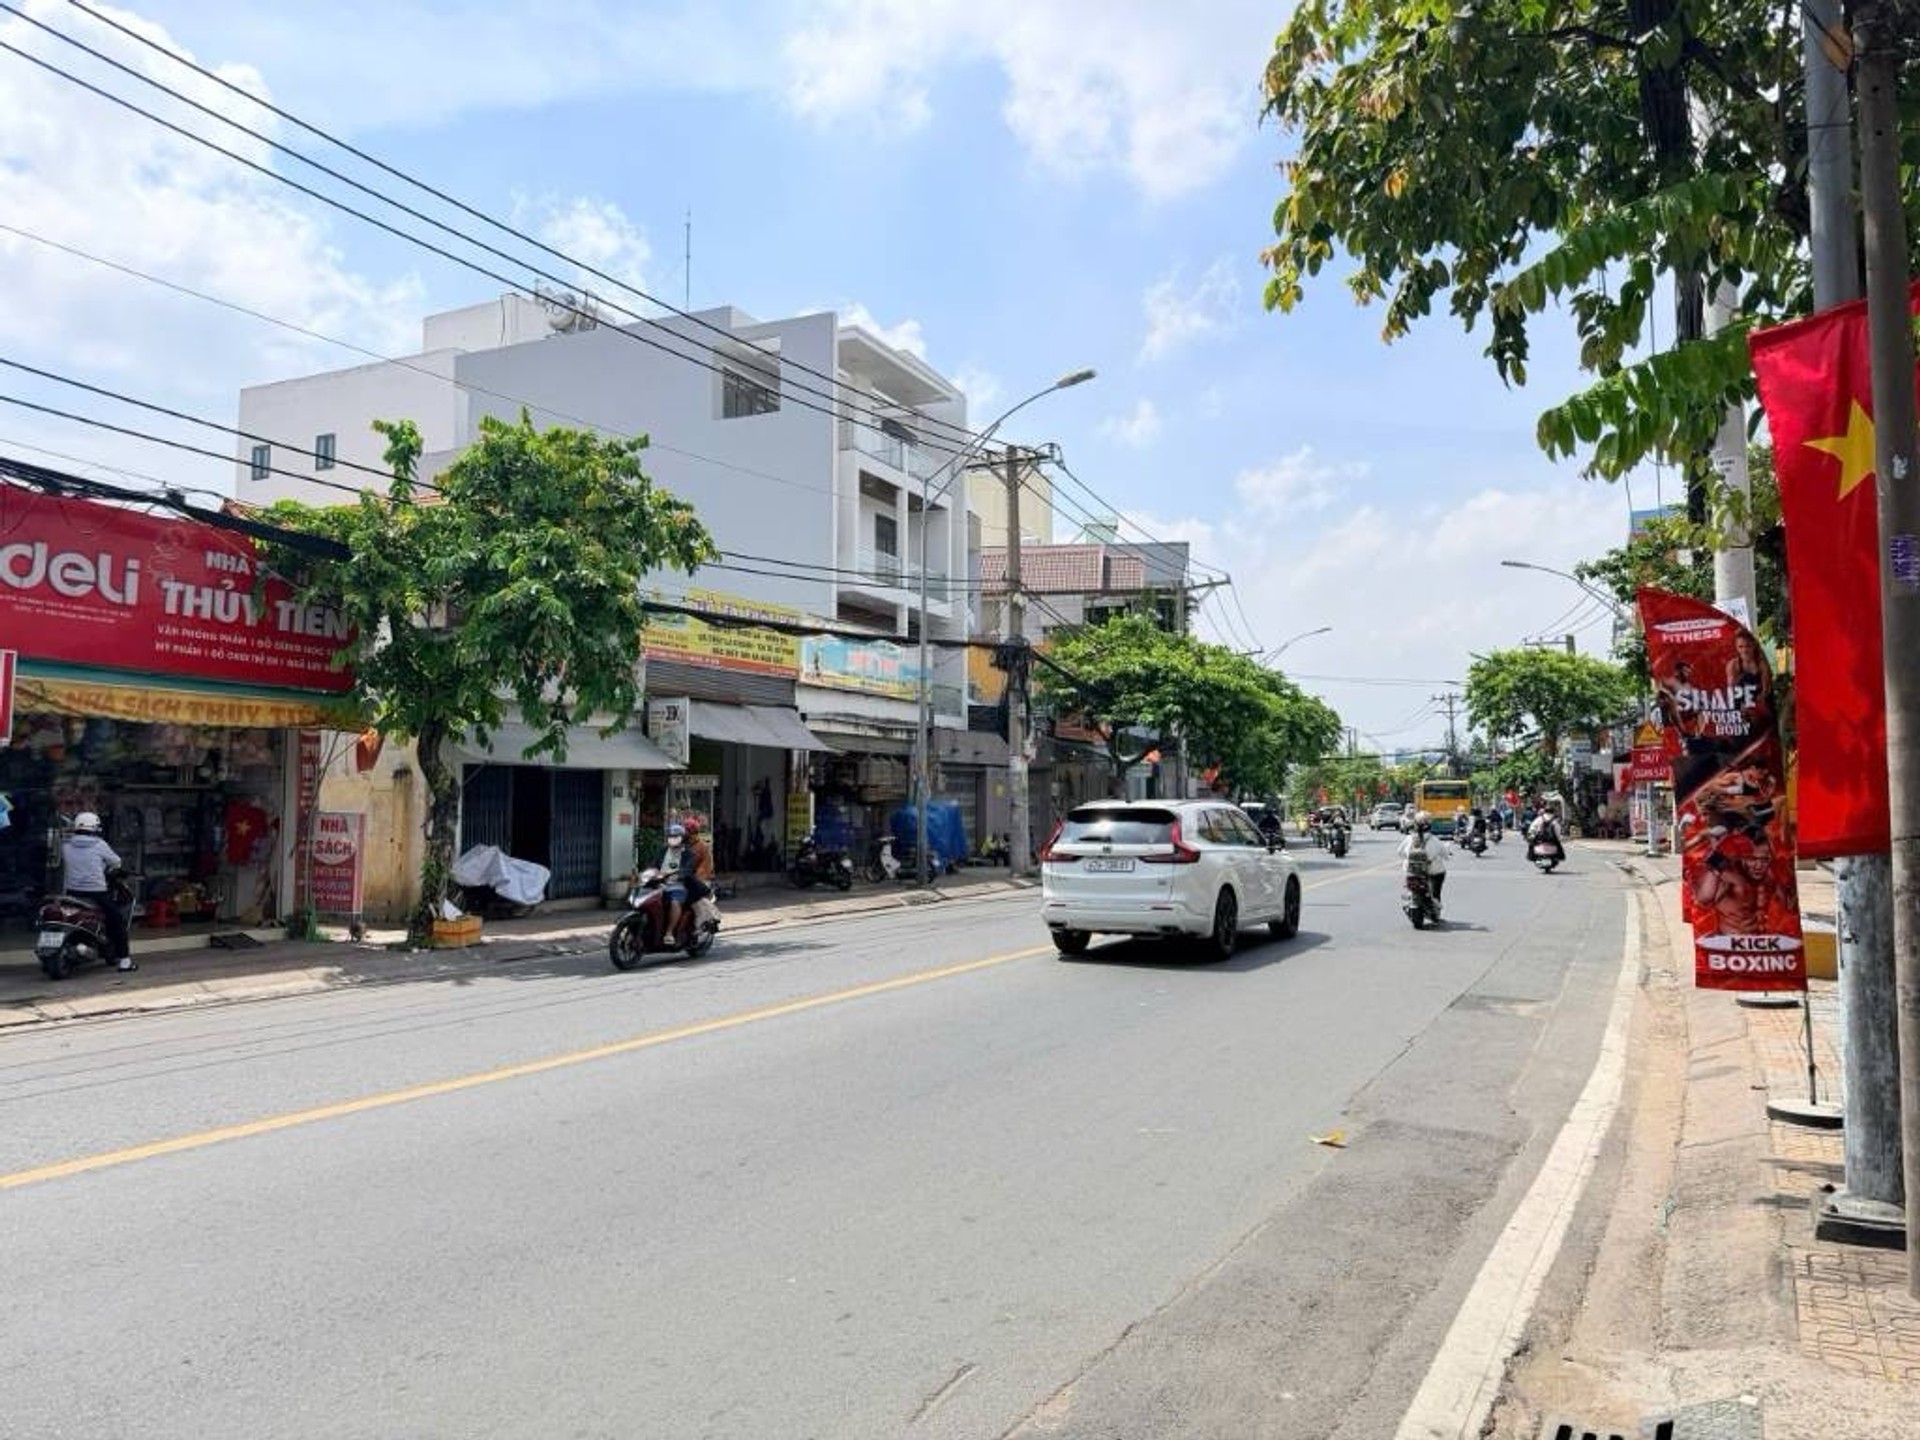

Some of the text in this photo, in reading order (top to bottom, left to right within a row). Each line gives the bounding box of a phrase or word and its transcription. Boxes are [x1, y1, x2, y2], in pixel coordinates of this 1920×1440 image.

[0, 541, 139, 604] deli
[205, 551, 250, 575] NHÀ
[1661, 628, 1722, 643] FITNESS
[1675, 684, 1757, 711] SHAPE
[1702, 710, 1742, 724] YOUR
[1715, 722, 1751, 736] BODY
[315, 836, 352, 856] SÁCH
[1730, 937, 1781, 951] KICK
[1708, 953, 1798, 972] BOXING
